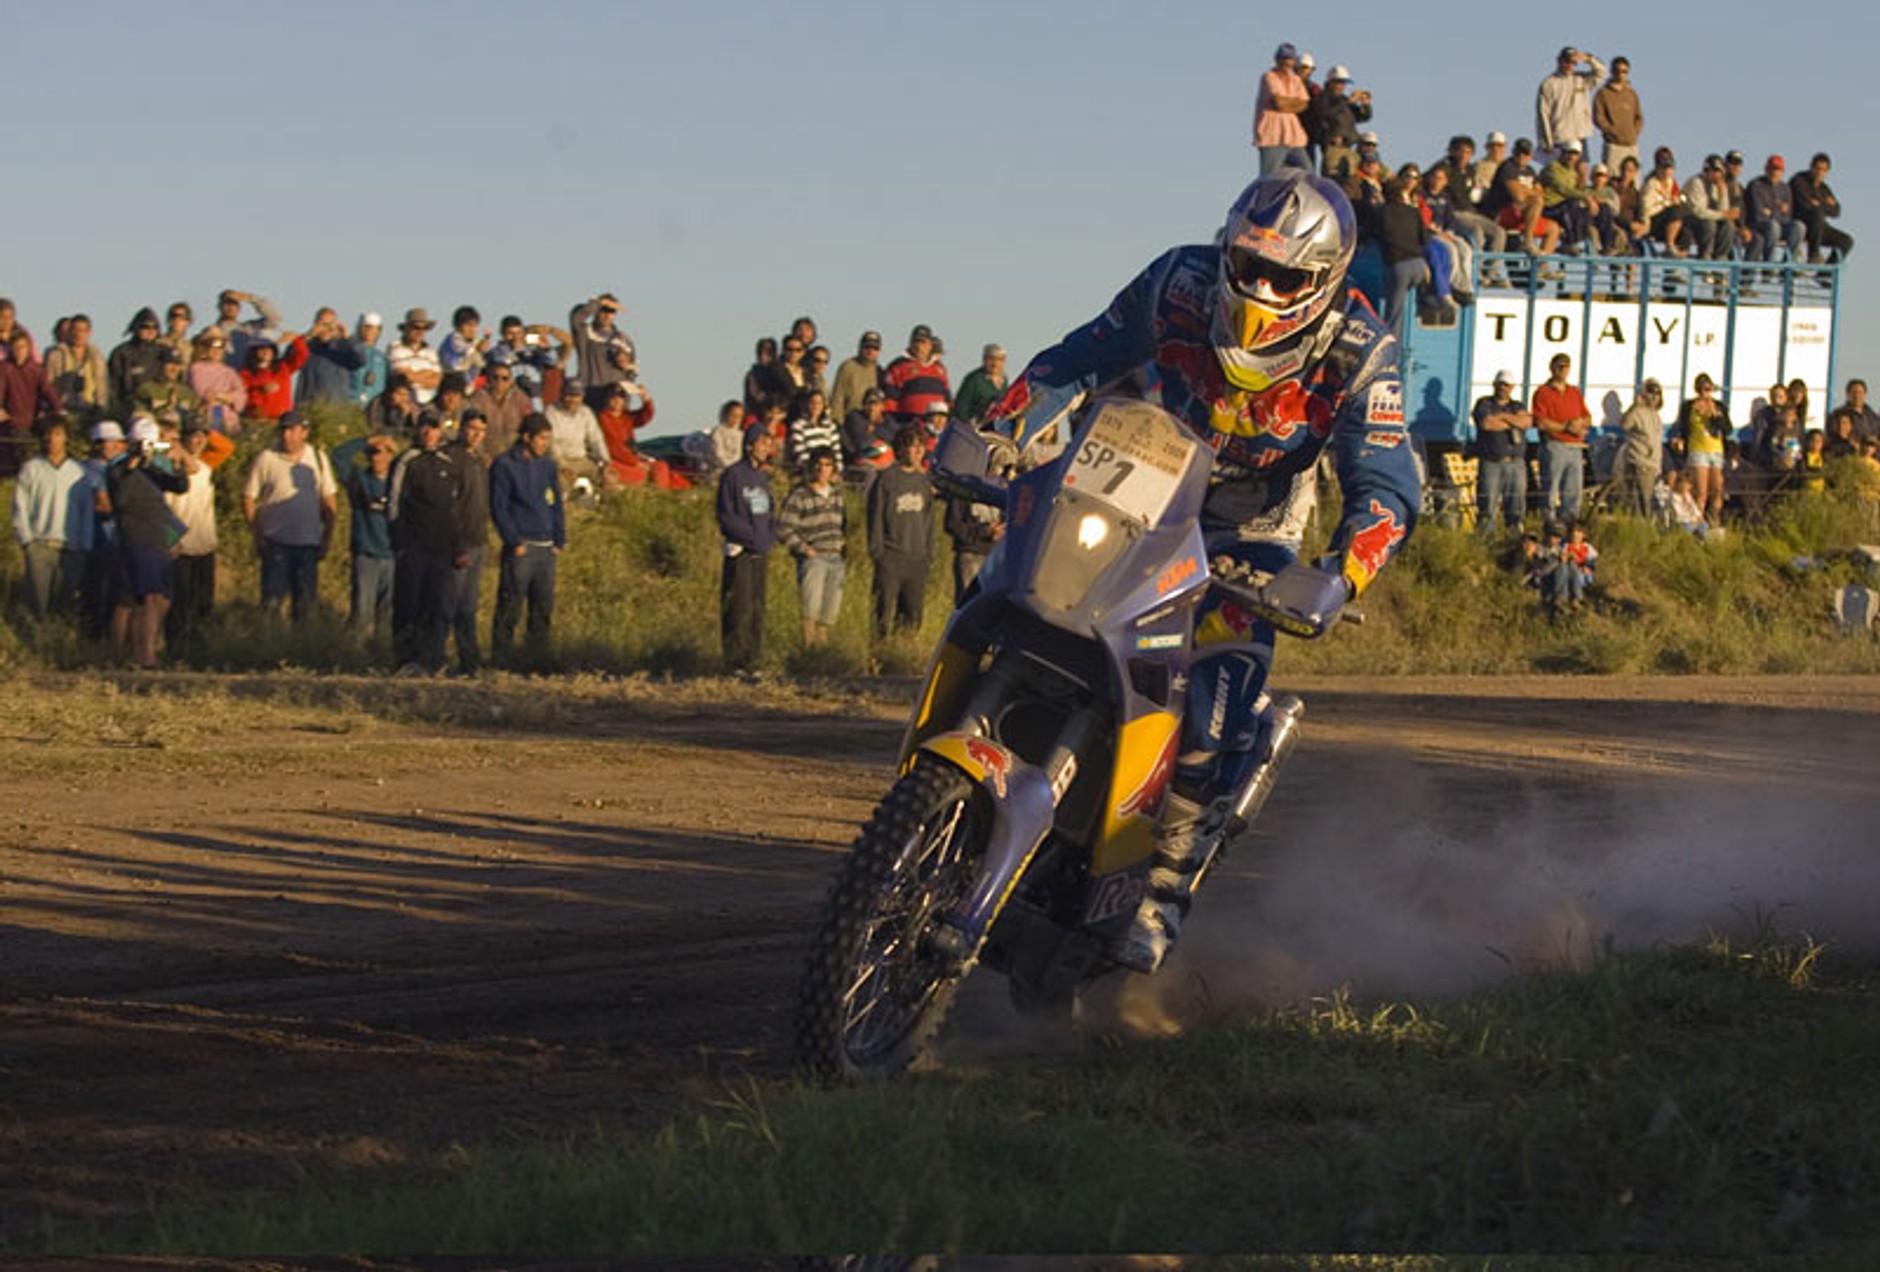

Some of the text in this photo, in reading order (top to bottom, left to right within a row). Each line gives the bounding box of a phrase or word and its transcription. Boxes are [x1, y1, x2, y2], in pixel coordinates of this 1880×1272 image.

[1485, 312, 1679, 344] TOAY
[1077, 441, 1135, 495] SP 1
